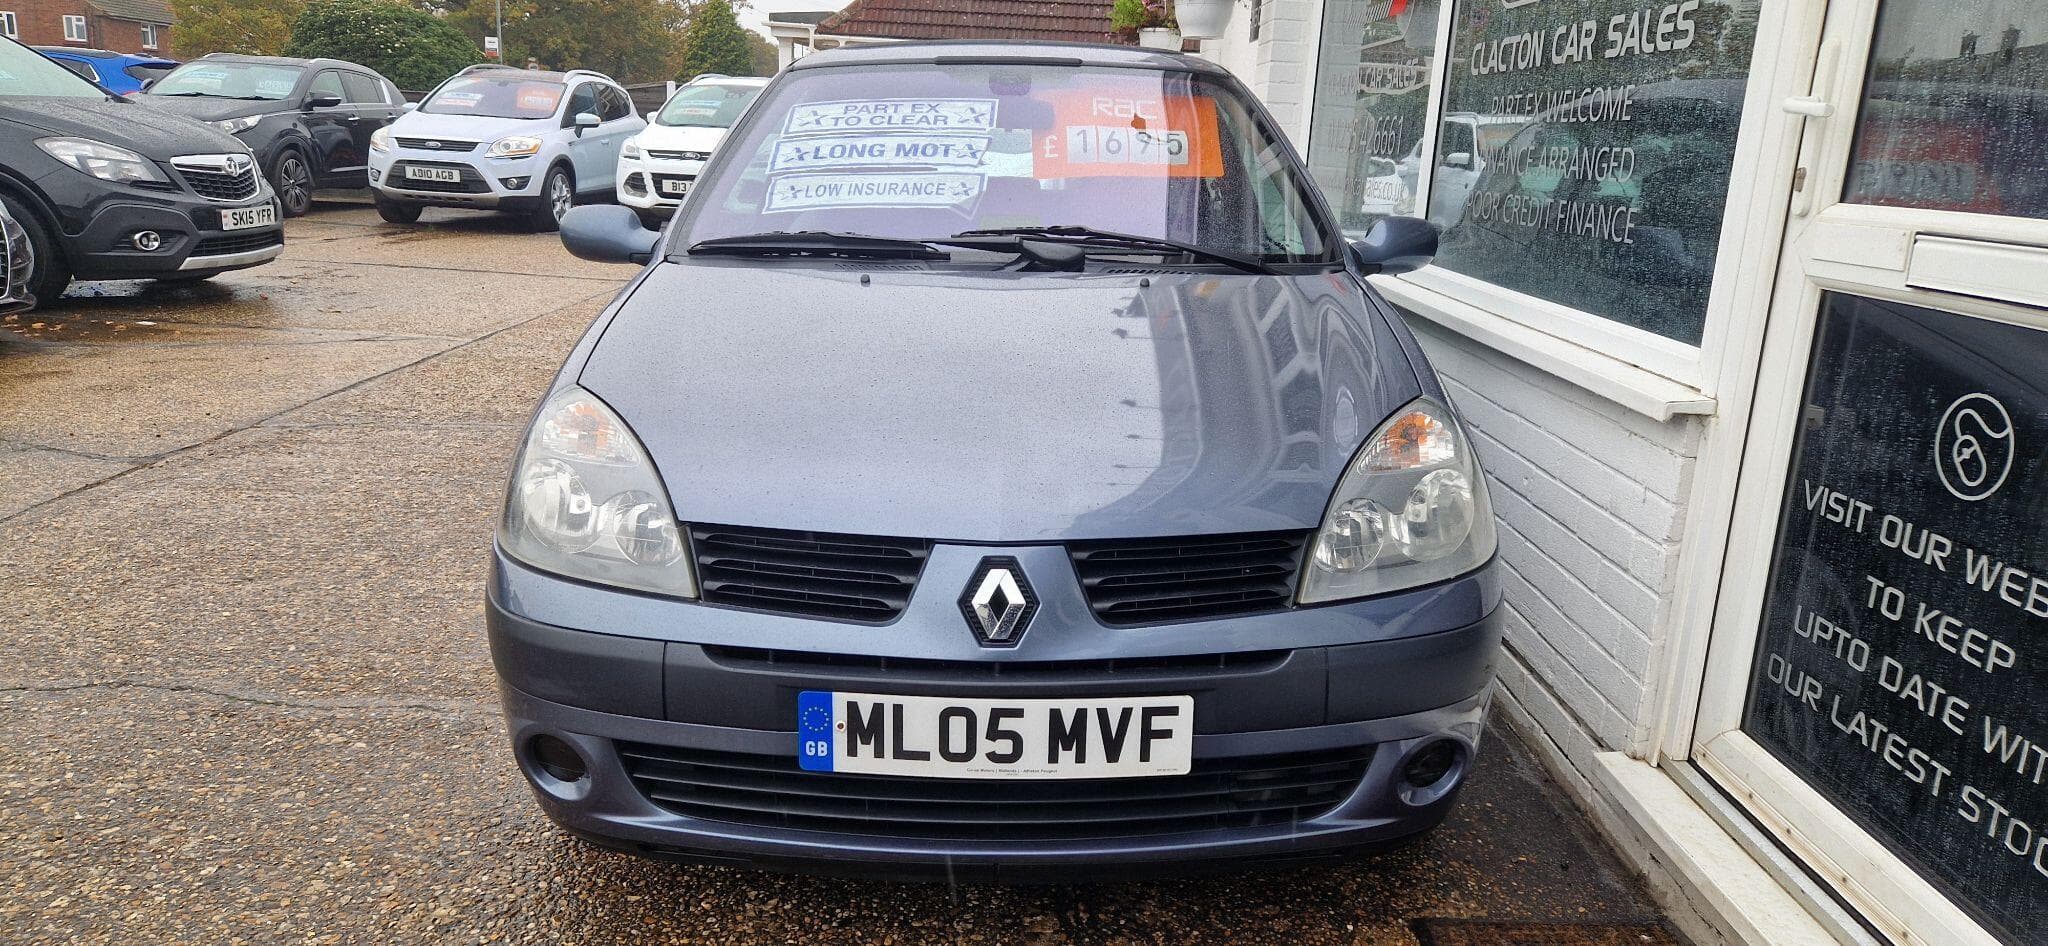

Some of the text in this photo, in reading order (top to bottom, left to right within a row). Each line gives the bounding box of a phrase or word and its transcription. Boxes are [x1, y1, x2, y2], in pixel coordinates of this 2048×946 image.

[1470, 0, 1700, 76] CLACTON CAR SALES
[1386, 57, 1419, 89] SALES
[831, 114, 949, 127] TO CLEAR
[843, 103, 941, 115] PART EX
[1524, 92, 1544, 122] EX
[1545, 84, 1636, 124] WELCOME
[812, 142, 956, 160] LONG MOT
[1479, 145, 1636, 183] INANCE ARRANGED
[804, 182, 947, 199] LOW INSURANCE
[231, 208, 272, 226] SK15 YFR
[1465, 189, 1640, 244] POOR CREDIT FINANCE
[1804, 478, 1874, 533] VISIT
[1879, 514, 1952, 572] OUR
[1866, 574, 2016, 673] TO KEEP
[1794, 605, 1870, 672] UPTO
[1878, 655, 1970, 736] DATE
[846, 700, 1180, 764] ML05 MVF
[1767, 652, 1823, 712] OUR
[1831, 695, 1951, 797] LATEST
[805, 740, 828, 757] GB
